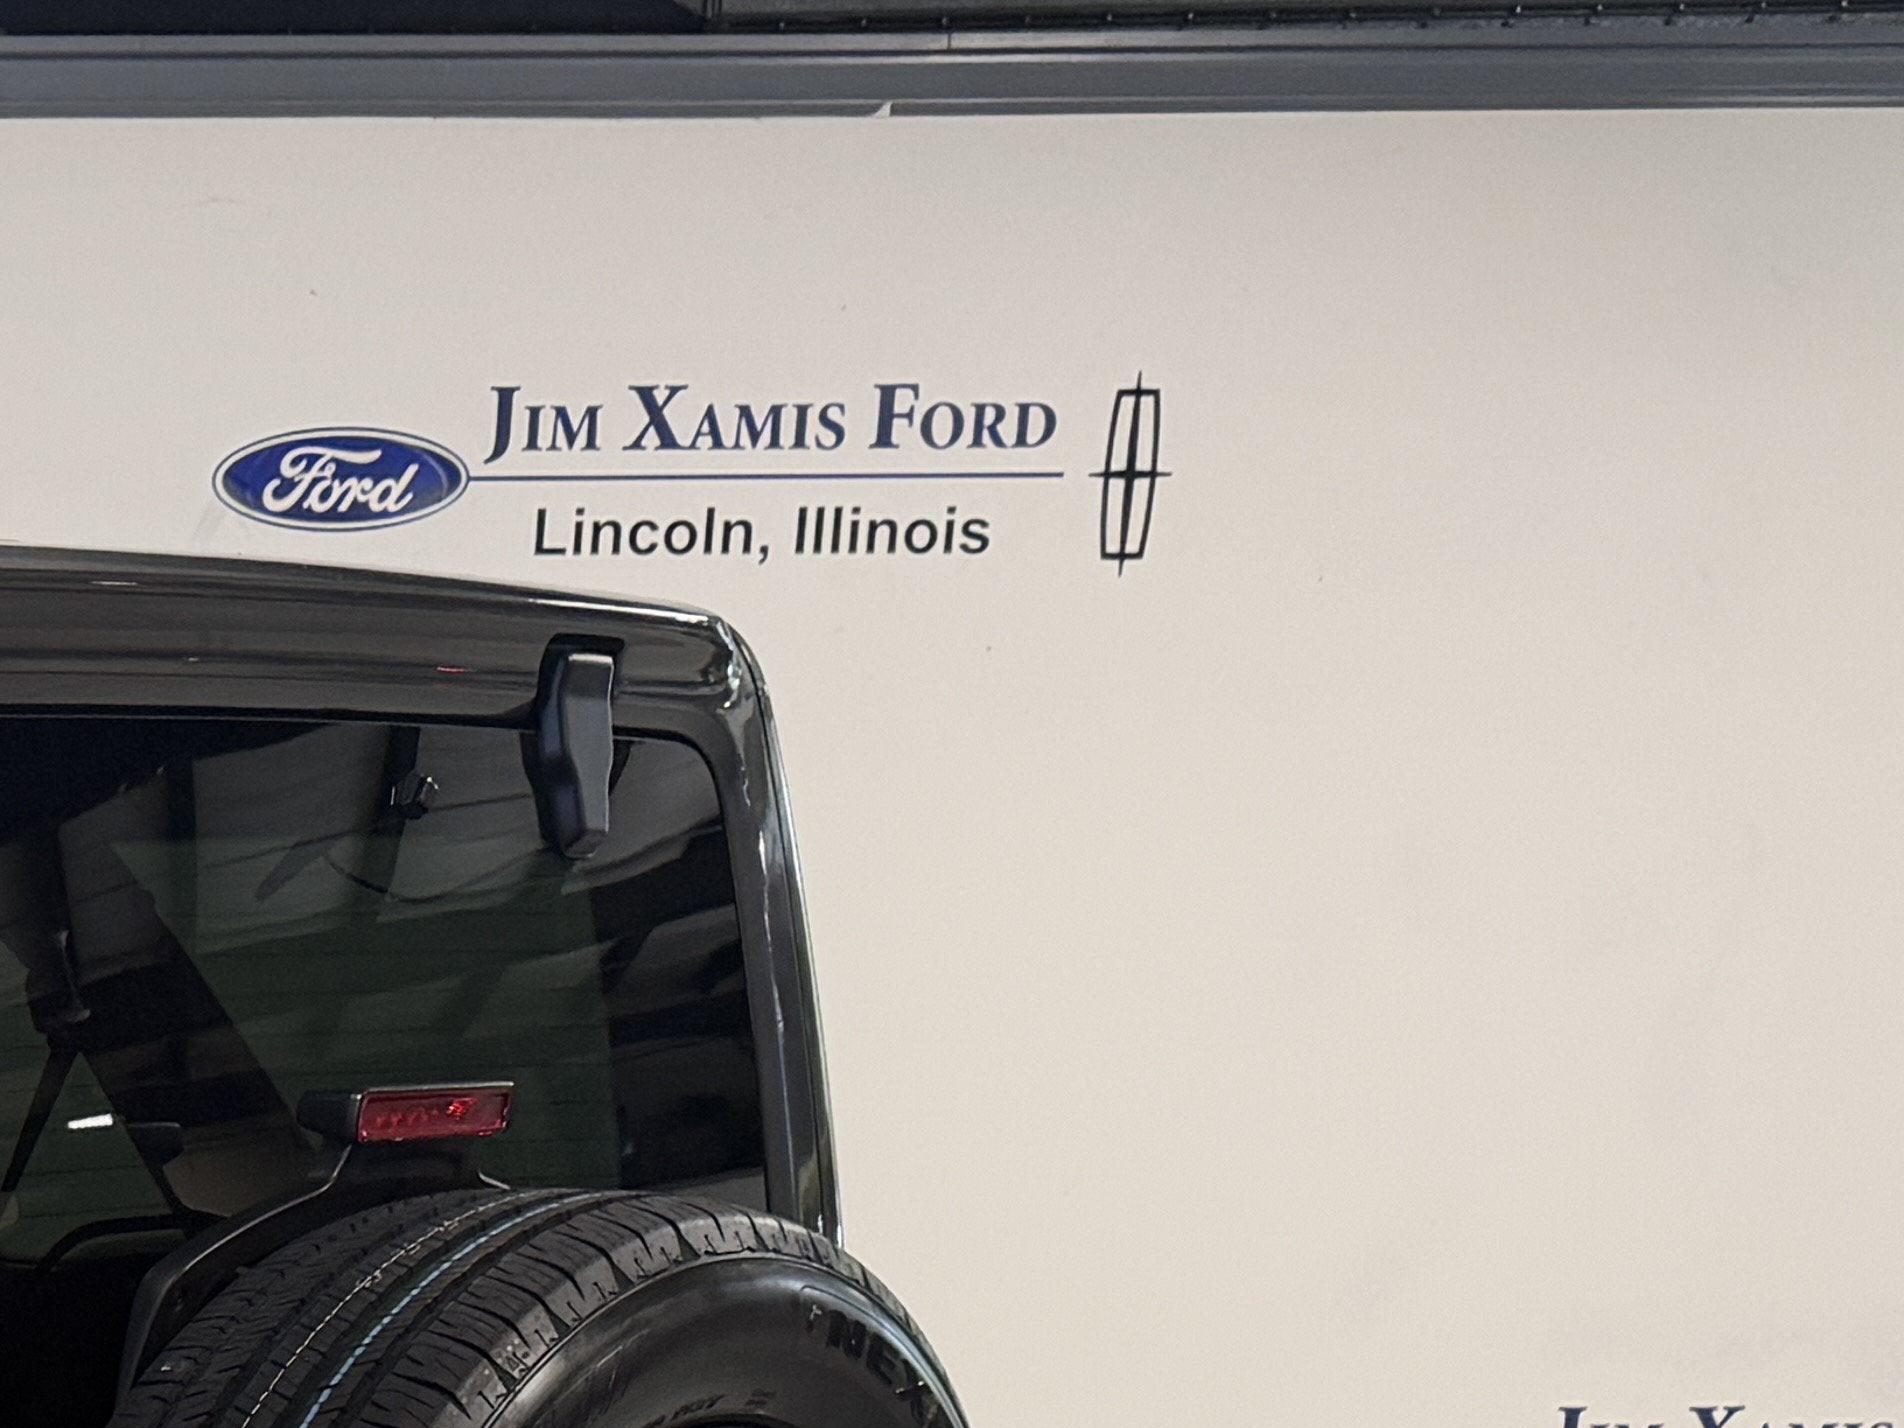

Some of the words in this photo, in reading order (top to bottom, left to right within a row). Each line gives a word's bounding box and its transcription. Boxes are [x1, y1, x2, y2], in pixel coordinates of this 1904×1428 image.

[484, 386, 602, 464] JIM
[622, 385, 845, 451] XAMIS
[868, 384, 1056, 449] FORD
[263, 446, 419, 512] Ford
[534, 507, 768, 564] Lincoln,
[795, 506, 989, 554] Illinois
